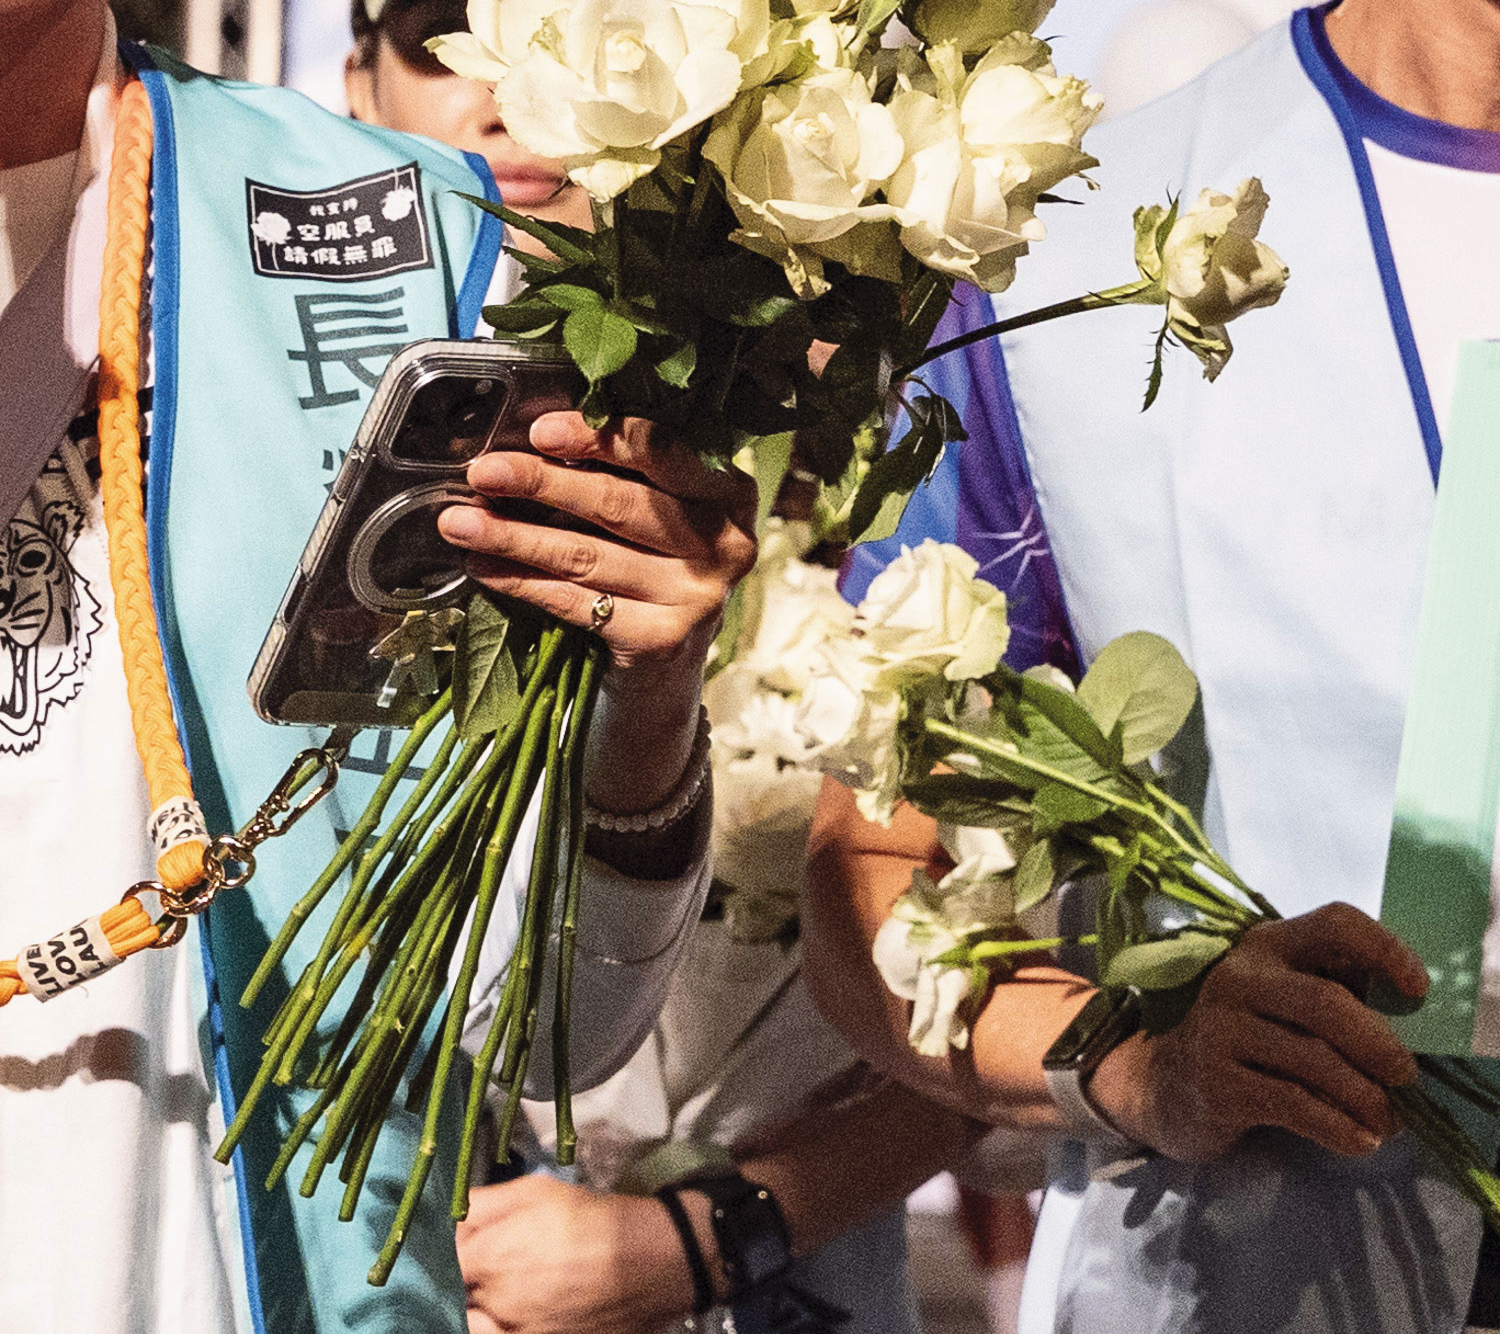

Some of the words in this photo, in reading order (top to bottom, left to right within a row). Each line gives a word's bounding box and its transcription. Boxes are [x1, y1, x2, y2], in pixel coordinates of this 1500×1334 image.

[297, 214, 375, 241] 空服員
[283, 236, 397, 265] 請假無罪
[47, 931, 88, 987] LOV
